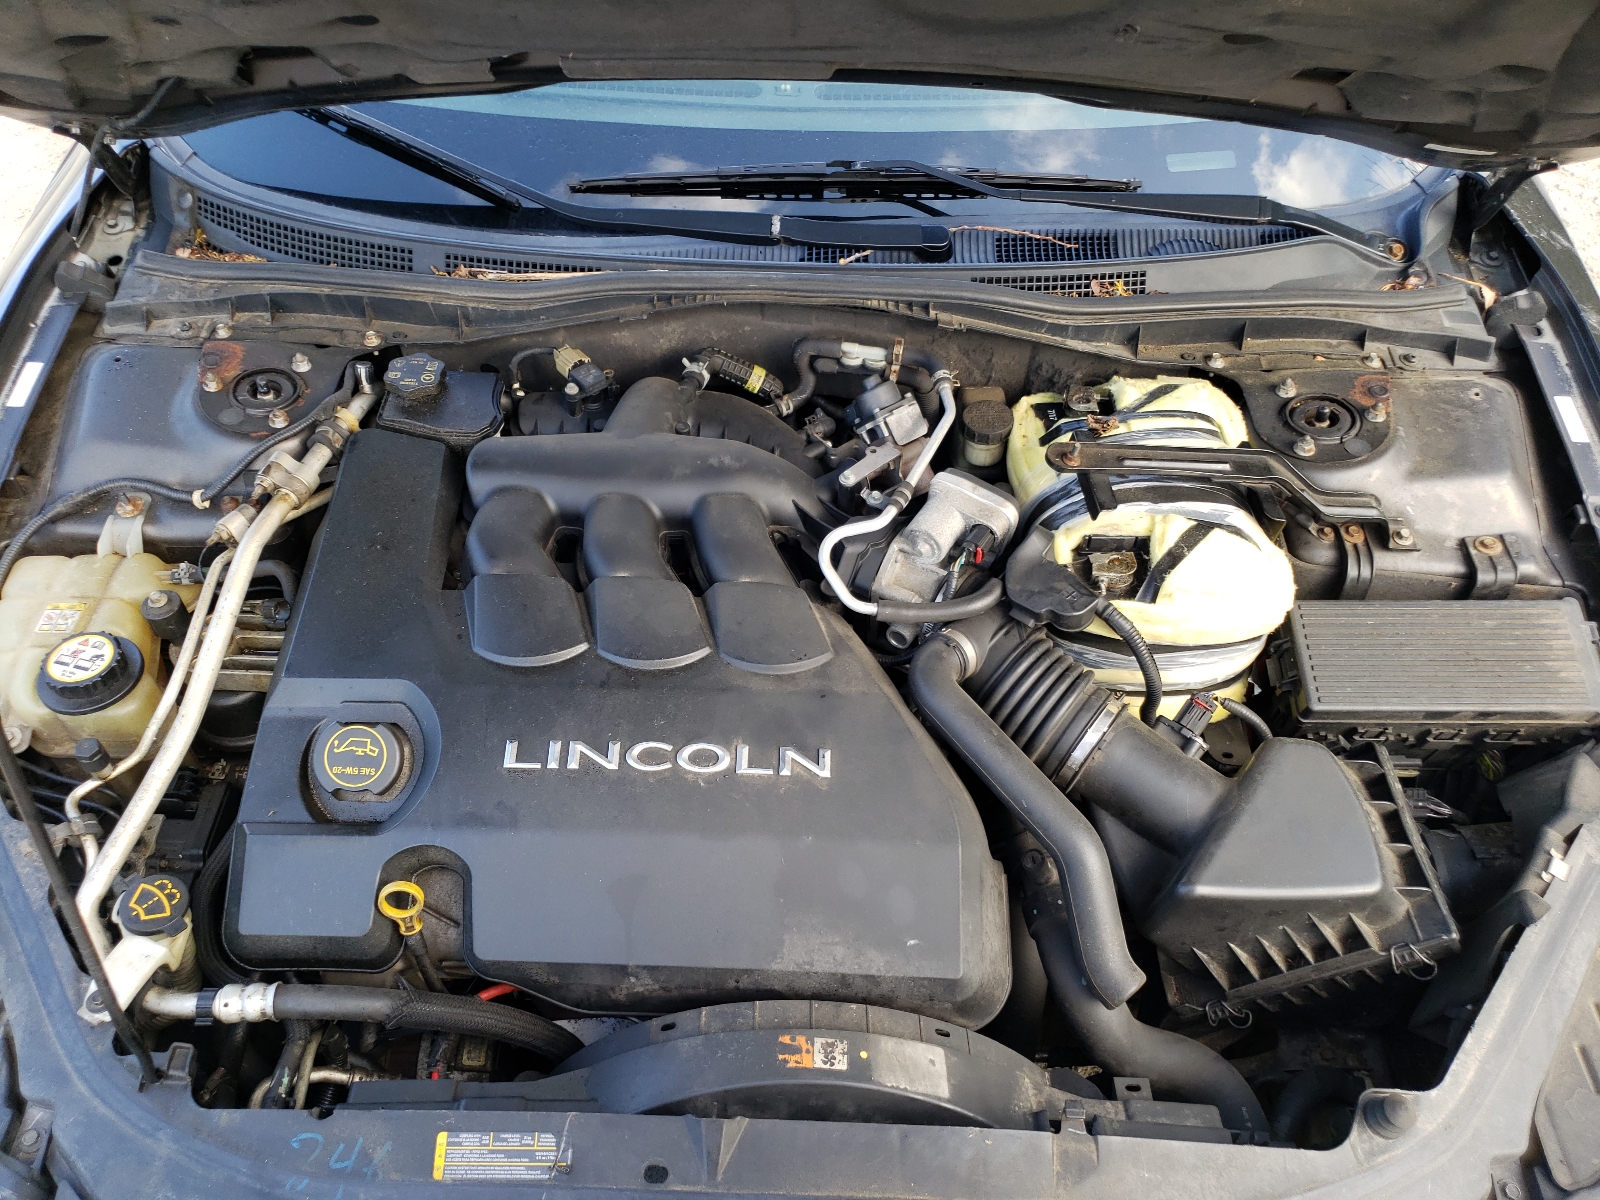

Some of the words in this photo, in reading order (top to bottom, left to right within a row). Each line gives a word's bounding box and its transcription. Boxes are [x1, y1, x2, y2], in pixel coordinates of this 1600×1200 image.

[503, 739, 831, 777] LINCOLN
[332, 766, 359, 775] 5W-20
[359, 767, 376, 776] SAE
